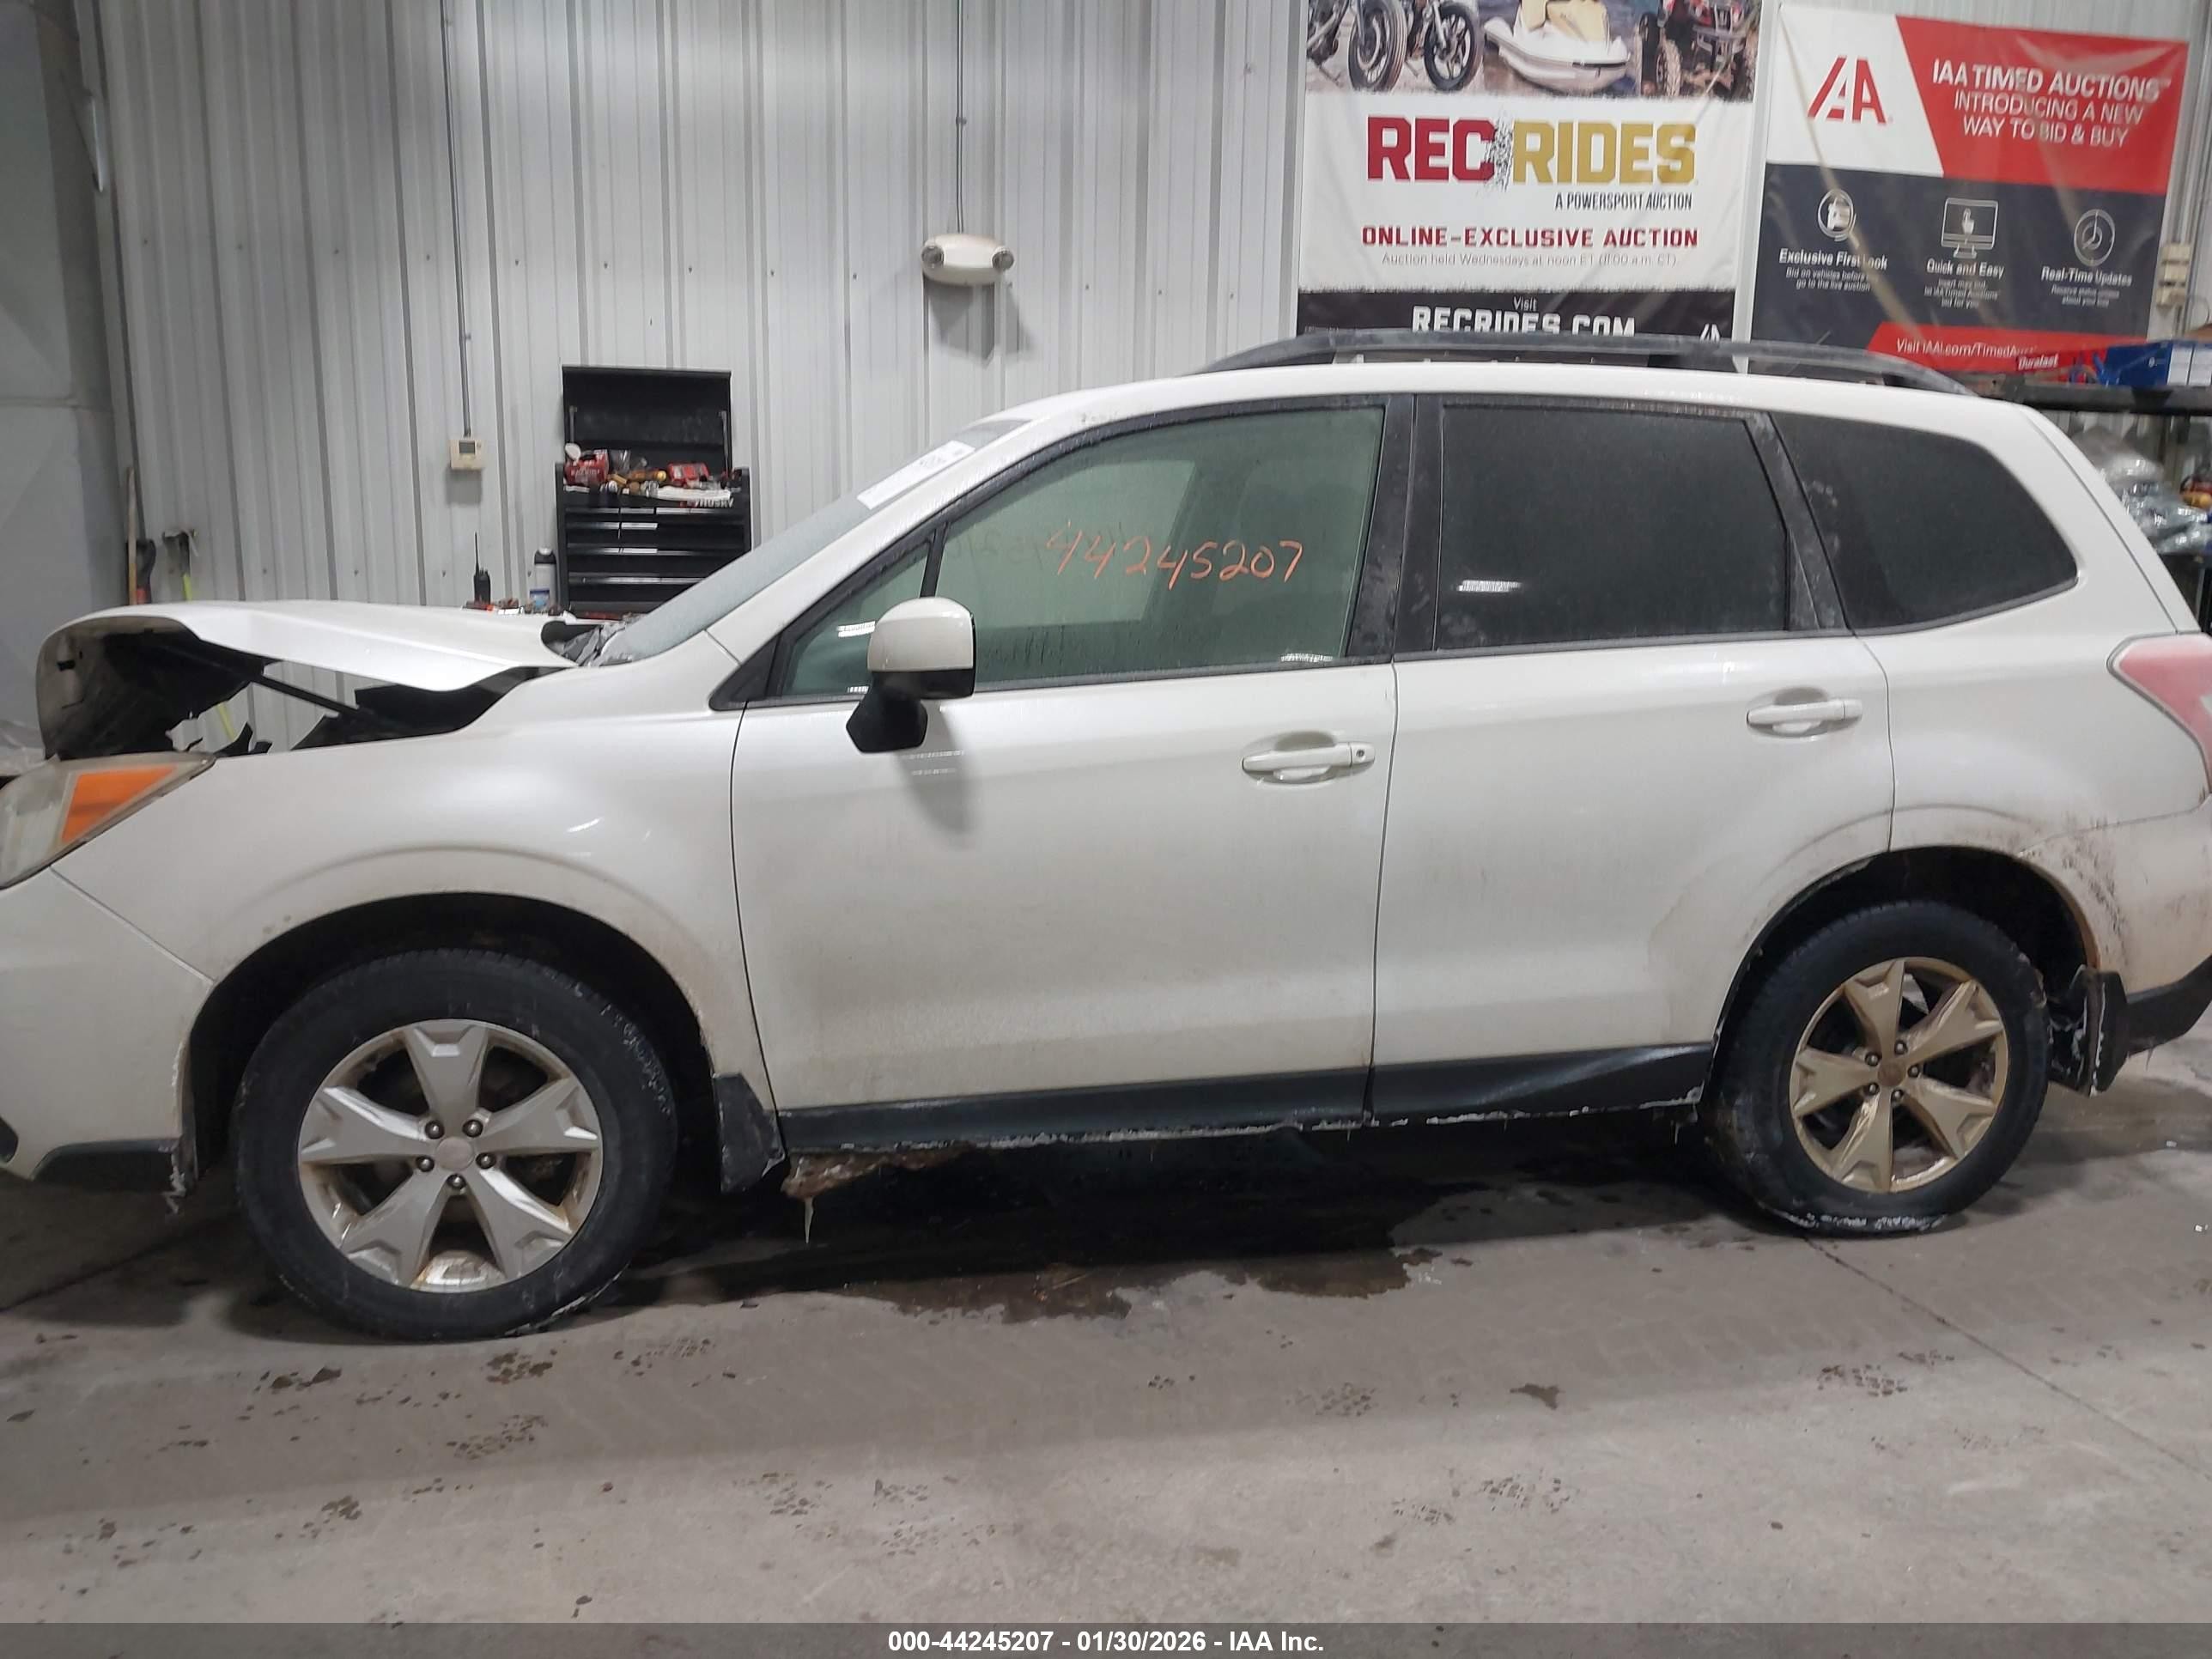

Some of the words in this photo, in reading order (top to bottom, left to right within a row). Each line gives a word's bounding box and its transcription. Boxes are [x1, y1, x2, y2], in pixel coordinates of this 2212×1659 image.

[1933, 58, 1968, 86] IAA
[1972, 64, 2044, 93] TIMED
[1954, 89, 2078, 121] INTRODUCING
[2081, 101, 2095, 121] A
[2100, 101, 2144, 125] NEW
[1963, 115, 2005, 137] WAY
[2009, 117, 2035, 140] TO
[2039, 121, 2068, 143] BID
[2070, 124, 2084, 145] &
[2090, 125, 2130, 148] BUY
[1367, 116, 1496, 182] REC
[1513, 118, 1697, 185] RIDES
[1555, 191, 1563, 210] A
[1567, 191, 1644, 211] POWERSPORT
[1645, 192, 1692, 211] AUCTION
[1362, 225, 1594, 248] ONLINE-EXCLUSIVE
[1603, 227, 1698, 248] AUCTION
[1382, 252, 1427, 265] Auction
[1431, 253, 1455, 265] held
[1459, 254, 1528, 268] Wednesdays
[1532, 254, 1542, 265] at
[1547, 256, 1577, 266] noon
[1778, 248, 1834, 266] Exclusive
[1836, 251, 1861, 268] First
[1926, 258, 1954, 275] Quick
[1956, 262, 1978, 275] and
[1978, 262, 2005, 280] Easy
[2041, 266, 2094, 283] Real-Time
[2095, 269, 2133, 287] Updates
[1513, 295, 1537, 311] Visit
[1896, 337, 1920, 354] Visit
[1046, 521, 1304, 591] 44245207
